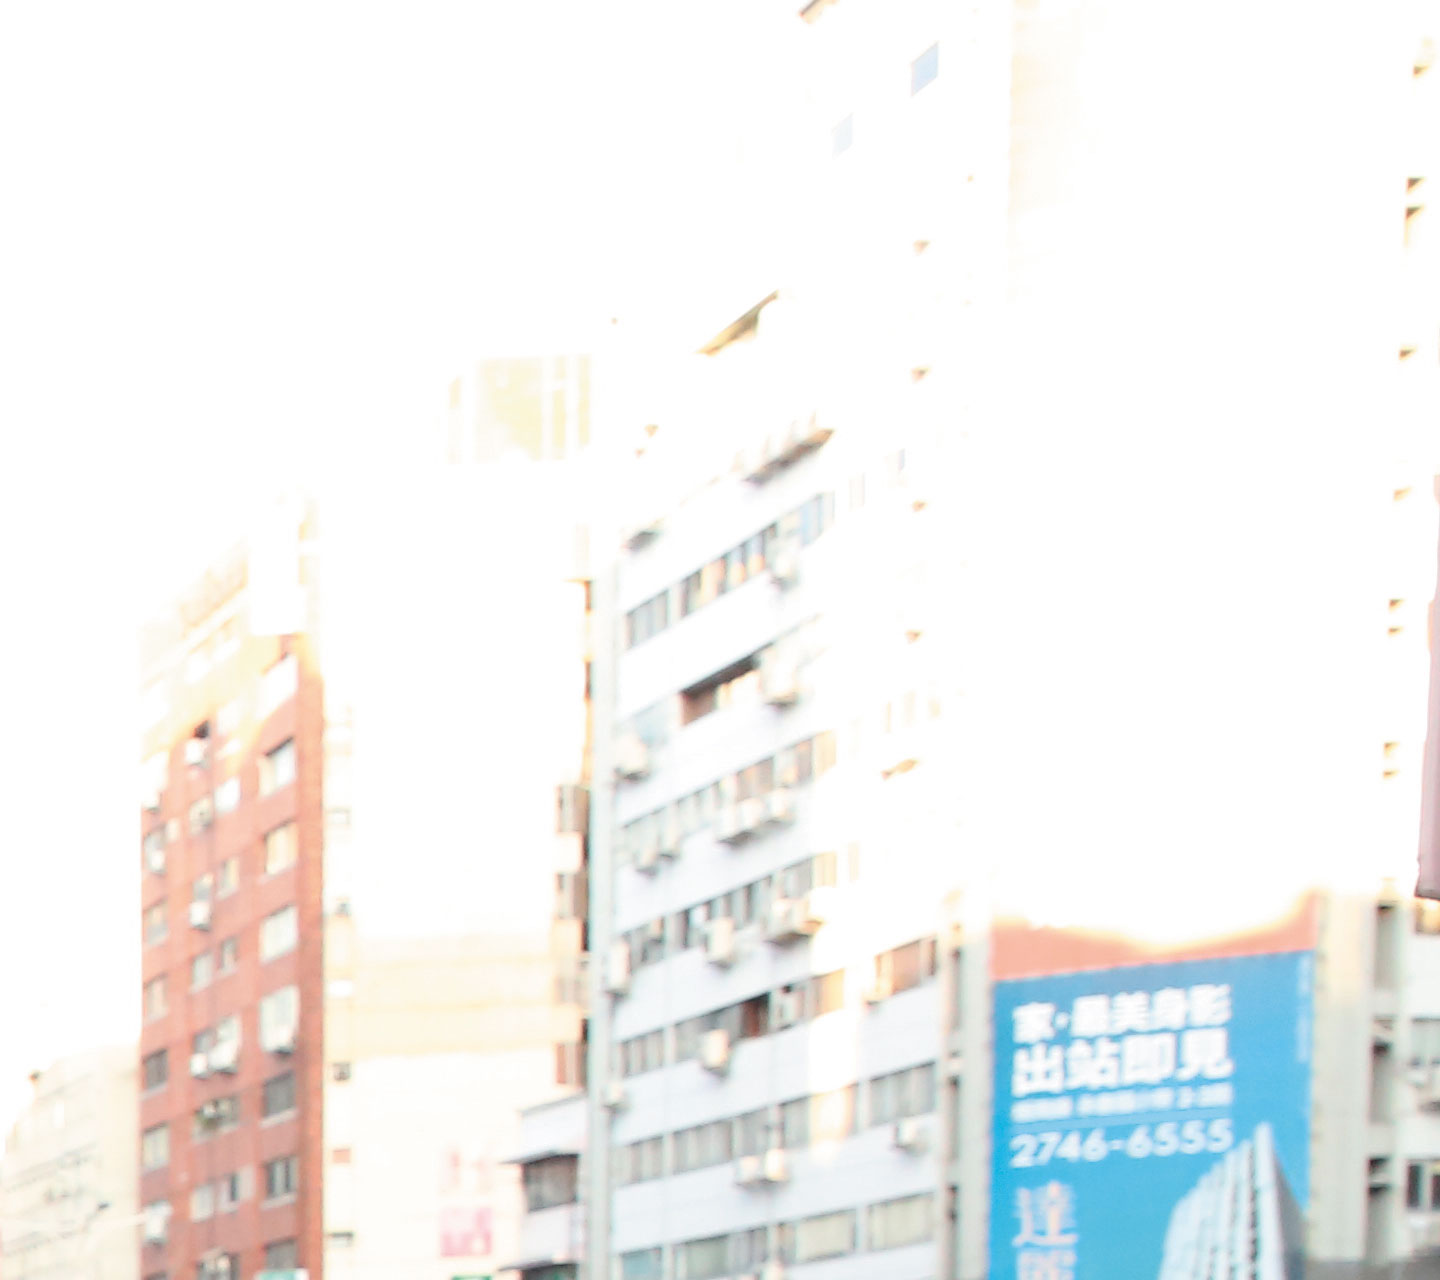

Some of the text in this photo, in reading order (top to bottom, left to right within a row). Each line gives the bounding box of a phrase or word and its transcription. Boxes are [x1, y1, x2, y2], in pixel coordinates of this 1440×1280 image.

[1011, 1026, 1235, 1097] 出站即見
[1008, 1117, 1234, 1169] 2746-6555
